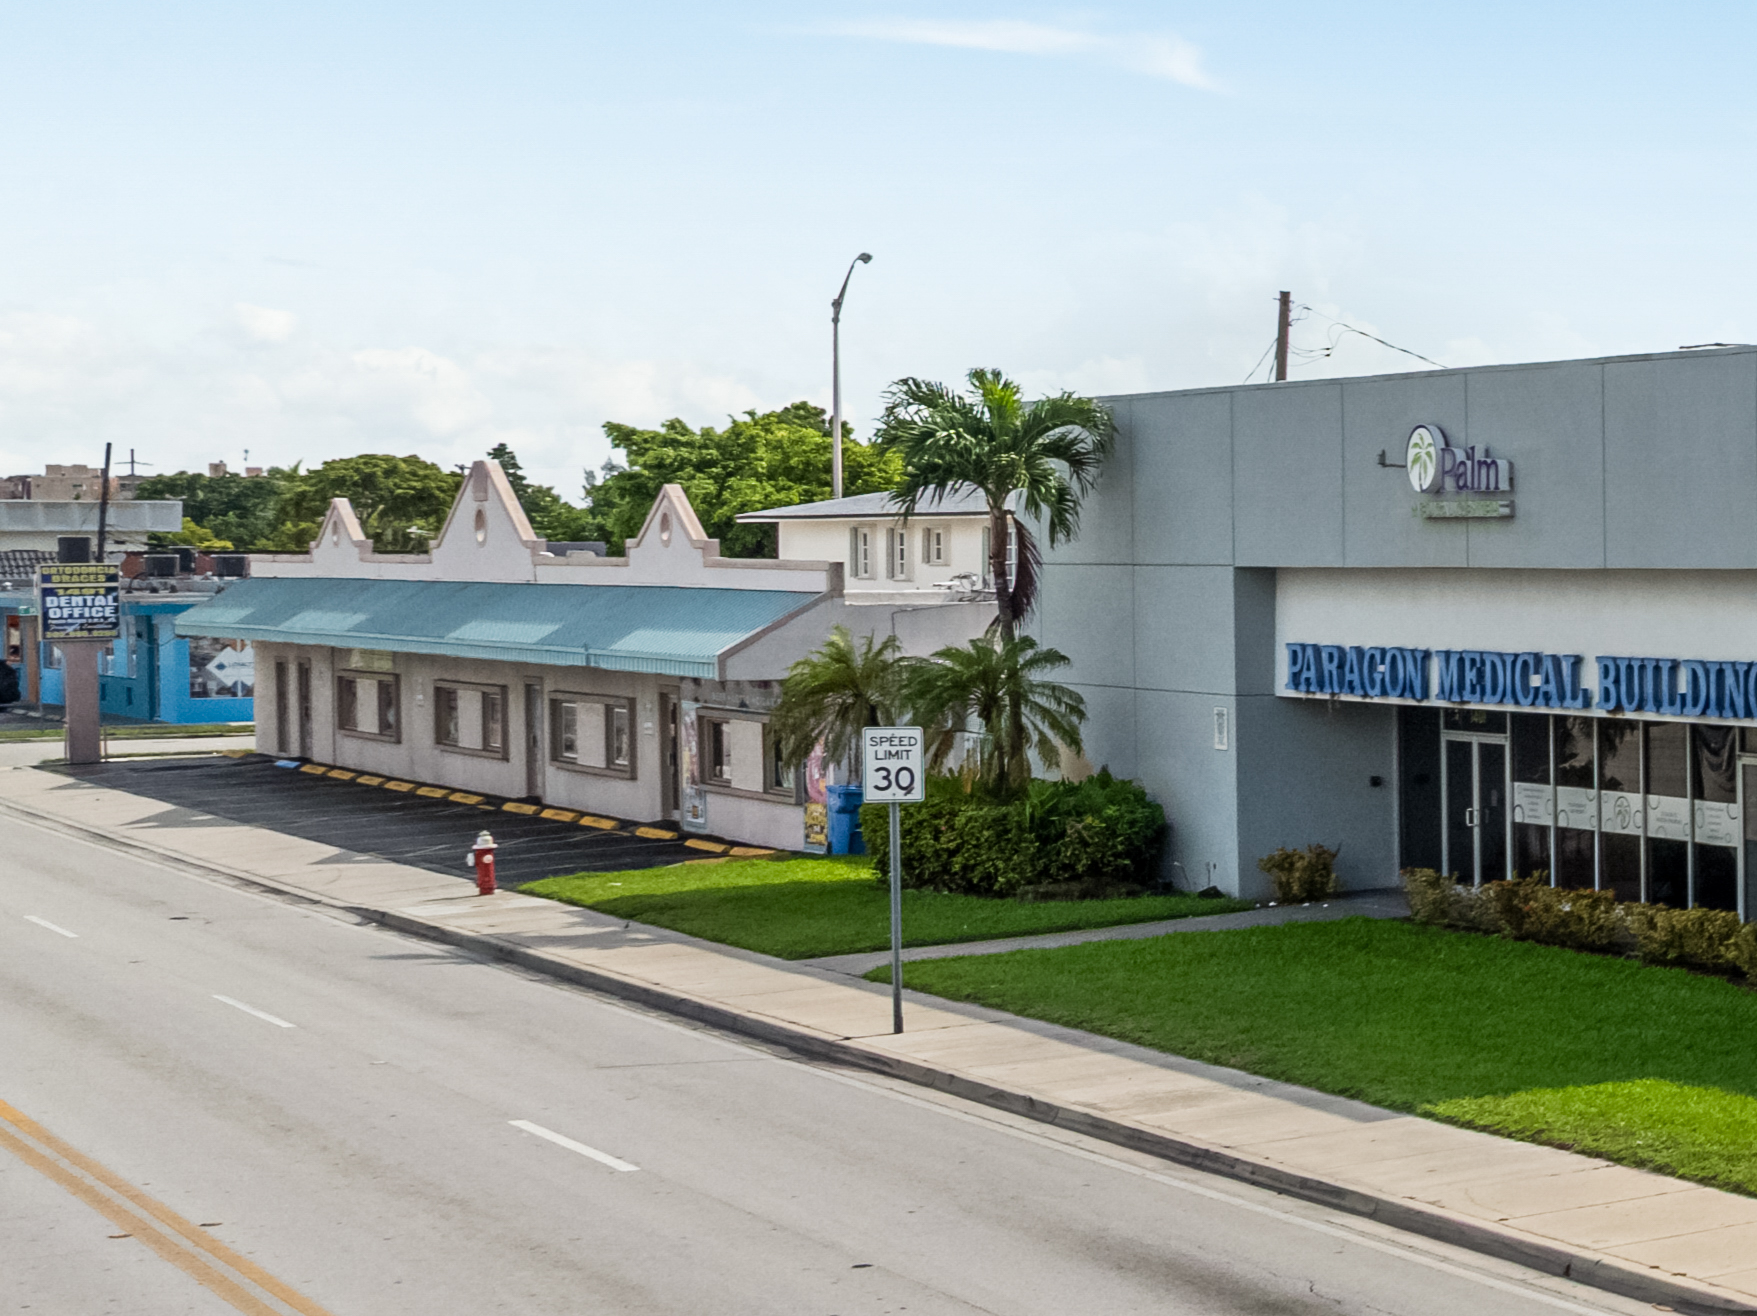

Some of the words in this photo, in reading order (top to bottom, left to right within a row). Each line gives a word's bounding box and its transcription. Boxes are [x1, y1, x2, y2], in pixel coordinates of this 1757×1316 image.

[1440, 444, 1501, 492] Palm
[45, 595, 118, 607] DENTAL
[48, 607, 116, 618] OFFICE
[1285, 642, 1430, 700] PARAGON
[1435, 649, 1590, 709] MEDICAL
[869, 736, 918, 747] SPEED
[874, 749, 912, 761] LIMIT
[873, 766, 915, 792] 30
